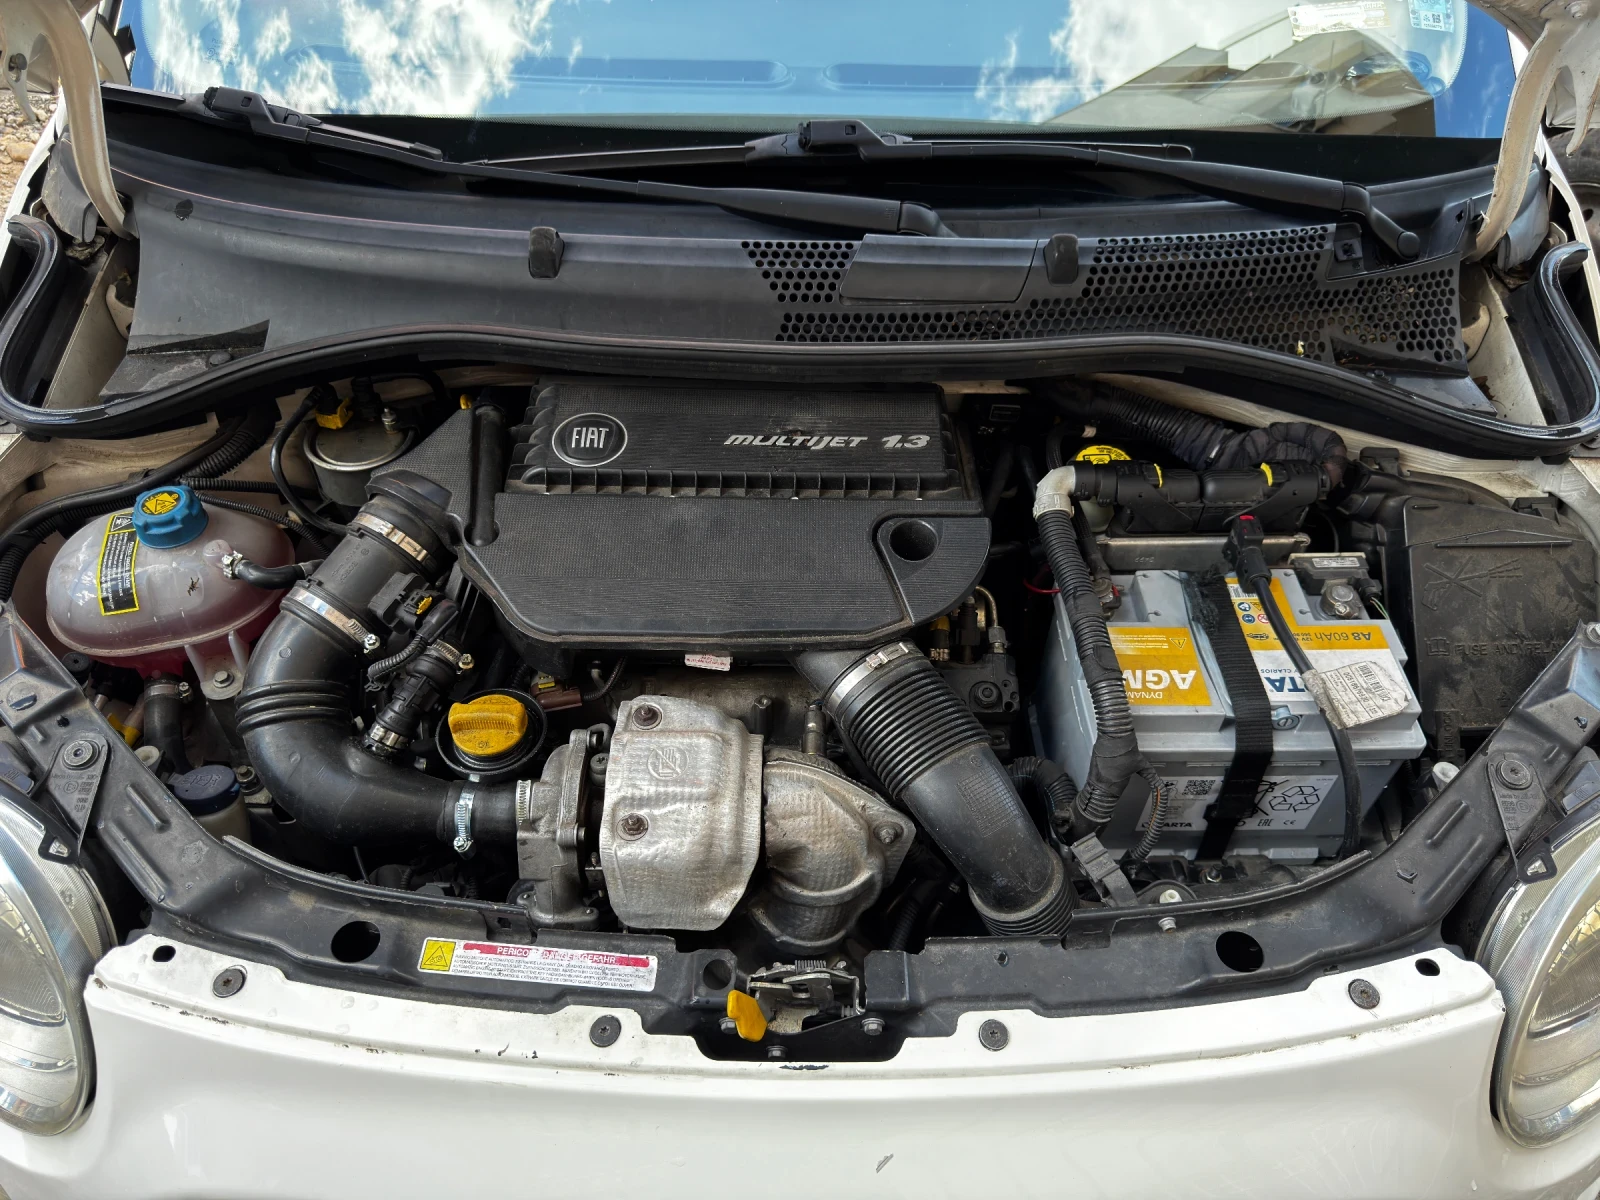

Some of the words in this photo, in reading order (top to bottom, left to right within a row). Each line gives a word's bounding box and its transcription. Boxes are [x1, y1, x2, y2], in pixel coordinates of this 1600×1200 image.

[571, 426, 610, 450] FIAT
[723, 434, 869, 450] MULTIJET
[881, 434, 932, 449] 1.3
[1315, 632, 1350, 641] 60Ah
[1352, 632, 1372, 641] A8
[1455, 643, 1488, 656] FUSE
[1525, 641, 1562, 655] RELA
[1122, 669, 1197, 690] AGM
[1125, 691, 1163, 699] DYNAM
[497, 946, 537, 957] PERICO
